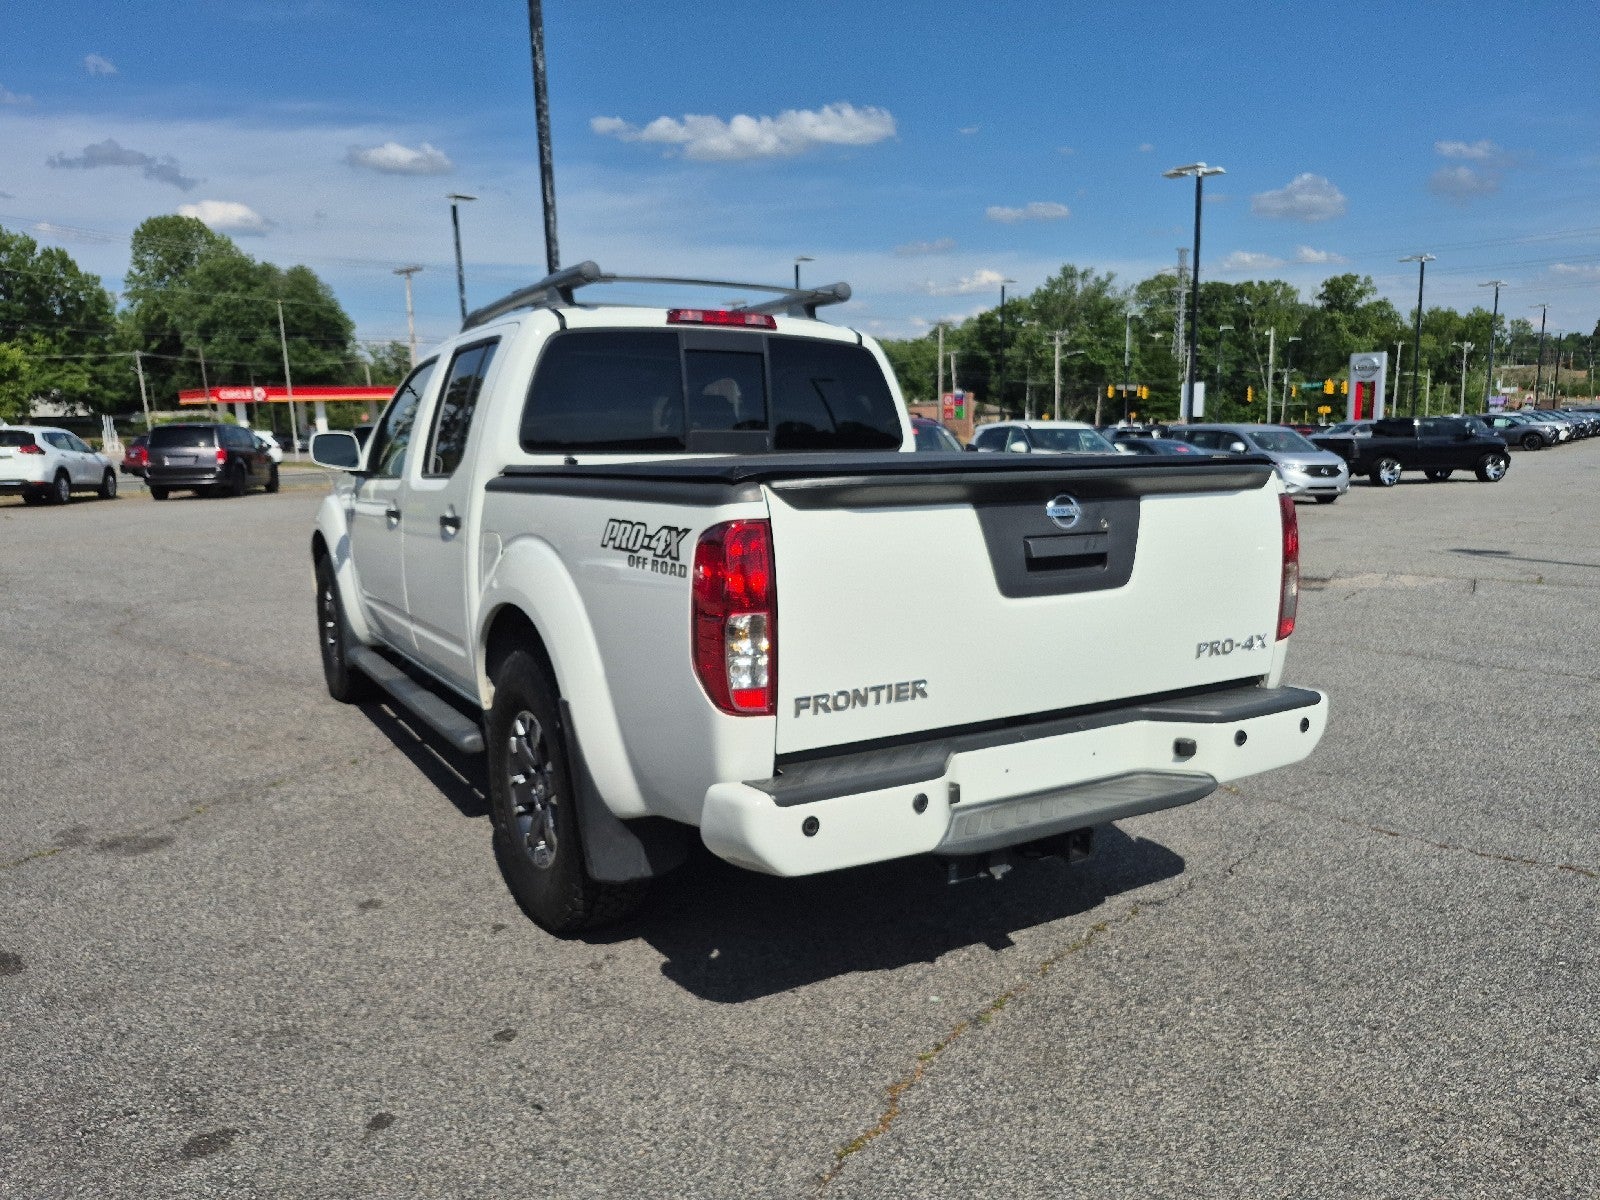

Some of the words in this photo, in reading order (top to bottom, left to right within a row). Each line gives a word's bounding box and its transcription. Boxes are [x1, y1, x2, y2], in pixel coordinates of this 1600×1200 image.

[601, 518, 692, 561] PRO-4X
[627, 554, 648, 570] OFF
[650, 559, 687, 579] ROAD
[1195, 633, 1267, 659] PRO-4X
[793, 678, 928, 718] FRONTIER
